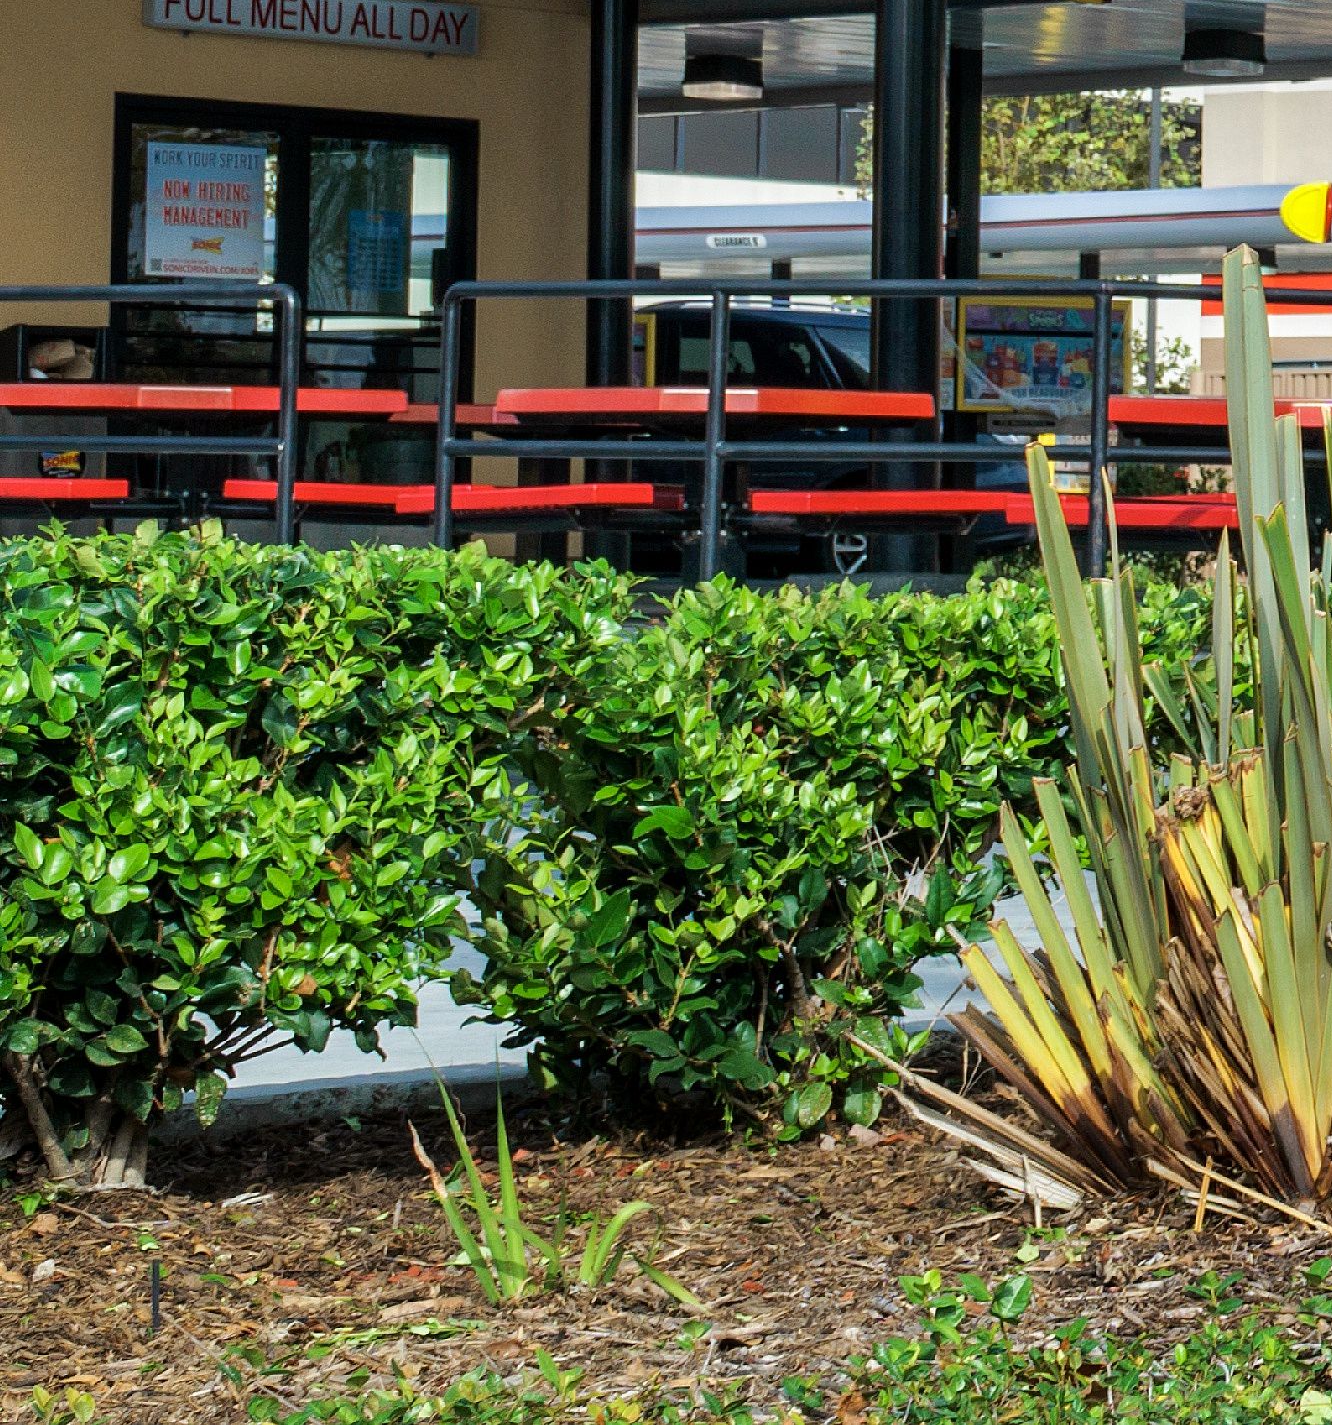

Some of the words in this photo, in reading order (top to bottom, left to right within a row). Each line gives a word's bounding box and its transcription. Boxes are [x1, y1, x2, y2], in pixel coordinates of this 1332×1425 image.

[350, 2, 403, 41] ALL
[408, 7, 470, 45] DAY
[153, 150, 183, 166] WORK
[188, 151, 217, 168] YOUR
[219, 154, 260, 171] SPIRIT
[163, 179, 191, 199] NOW
[197, 181, 250, 203] HIRING
[163, 205, 249, 230] MANAGEMENT
